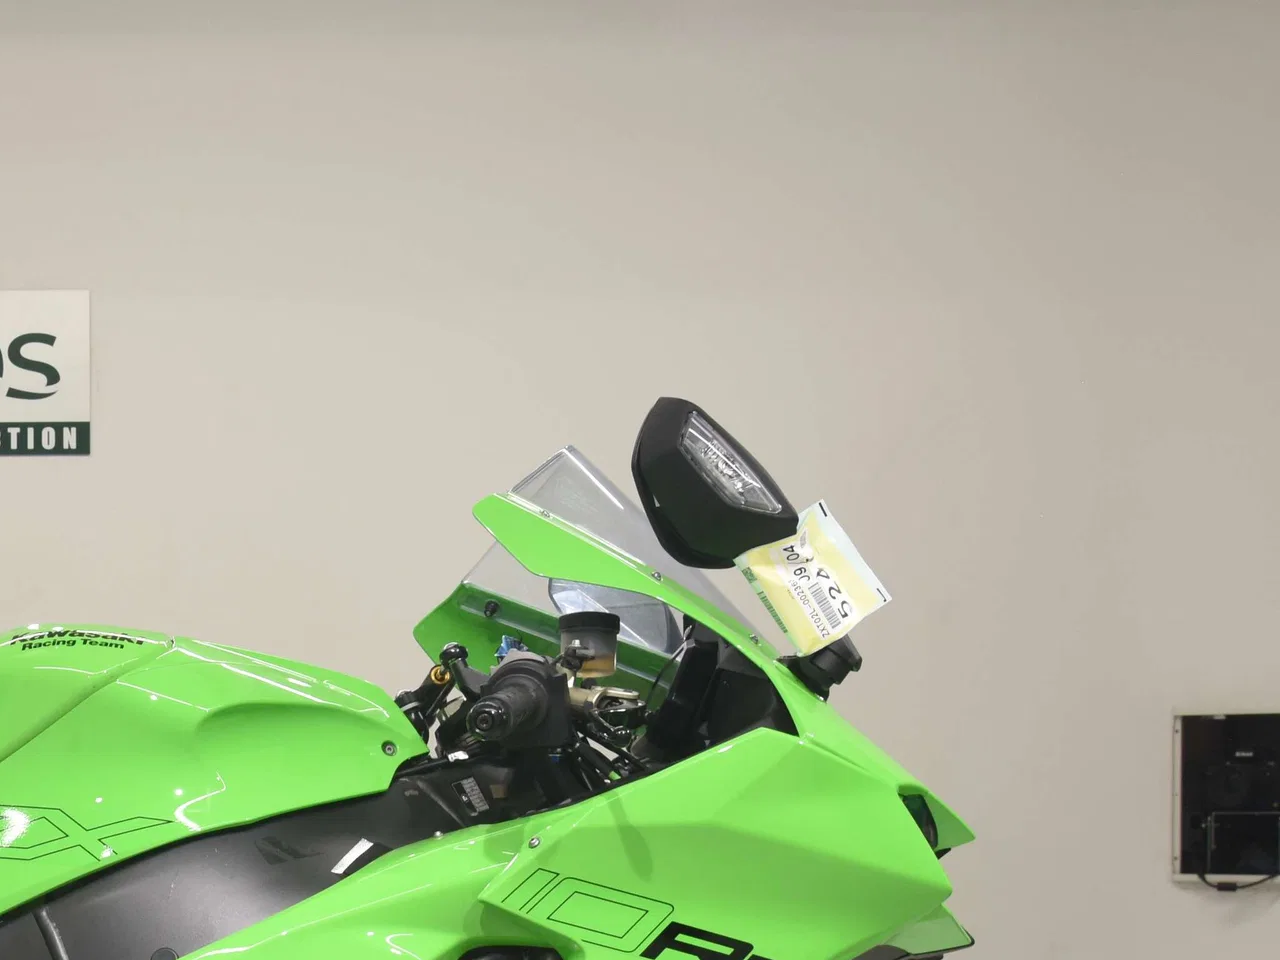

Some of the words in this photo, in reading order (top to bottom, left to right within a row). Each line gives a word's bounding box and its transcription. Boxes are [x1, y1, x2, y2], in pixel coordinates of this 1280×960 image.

[788, 579, 830, 638] ZXT02L-00236
[21, 638, 77, 651] Racing
[81, 638, 124, 649] Team
